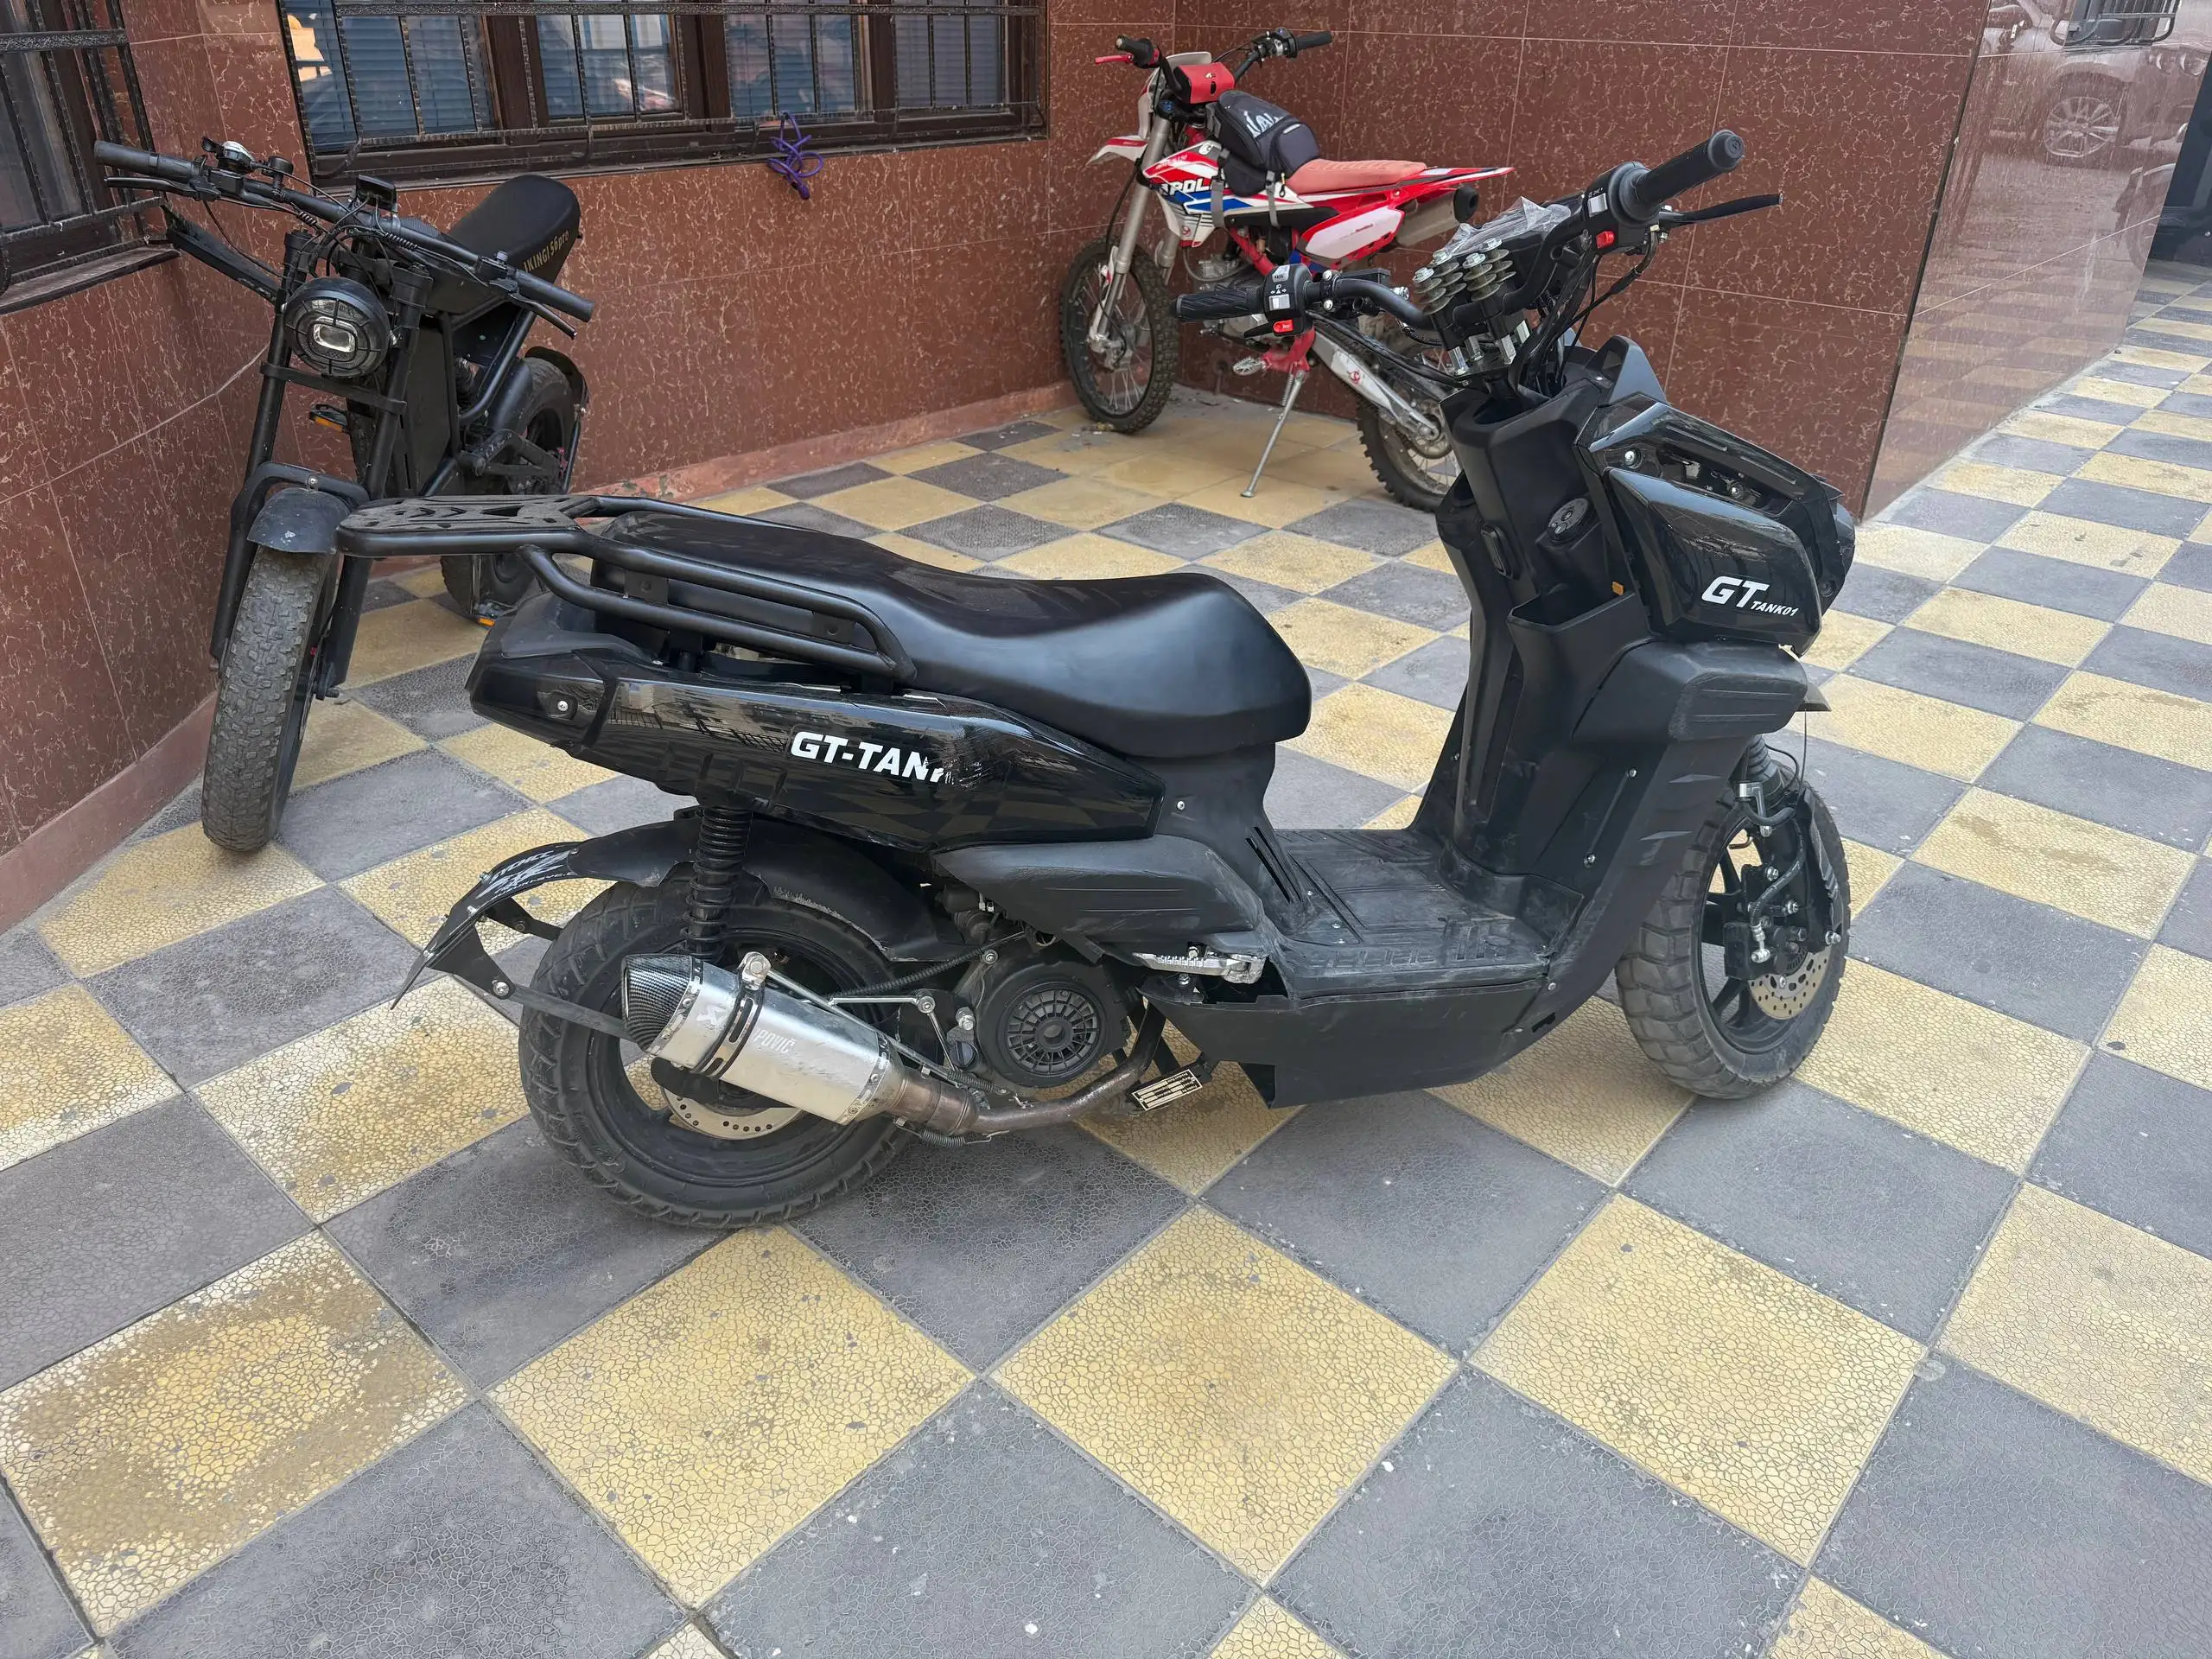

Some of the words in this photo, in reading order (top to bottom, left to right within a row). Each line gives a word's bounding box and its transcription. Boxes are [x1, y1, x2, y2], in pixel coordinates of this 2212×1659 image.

[1159, 178, 1212, 196] APOL
[1701, 575, 1770, 608] GT
[1751, 601, 1800, 617] TANK01
